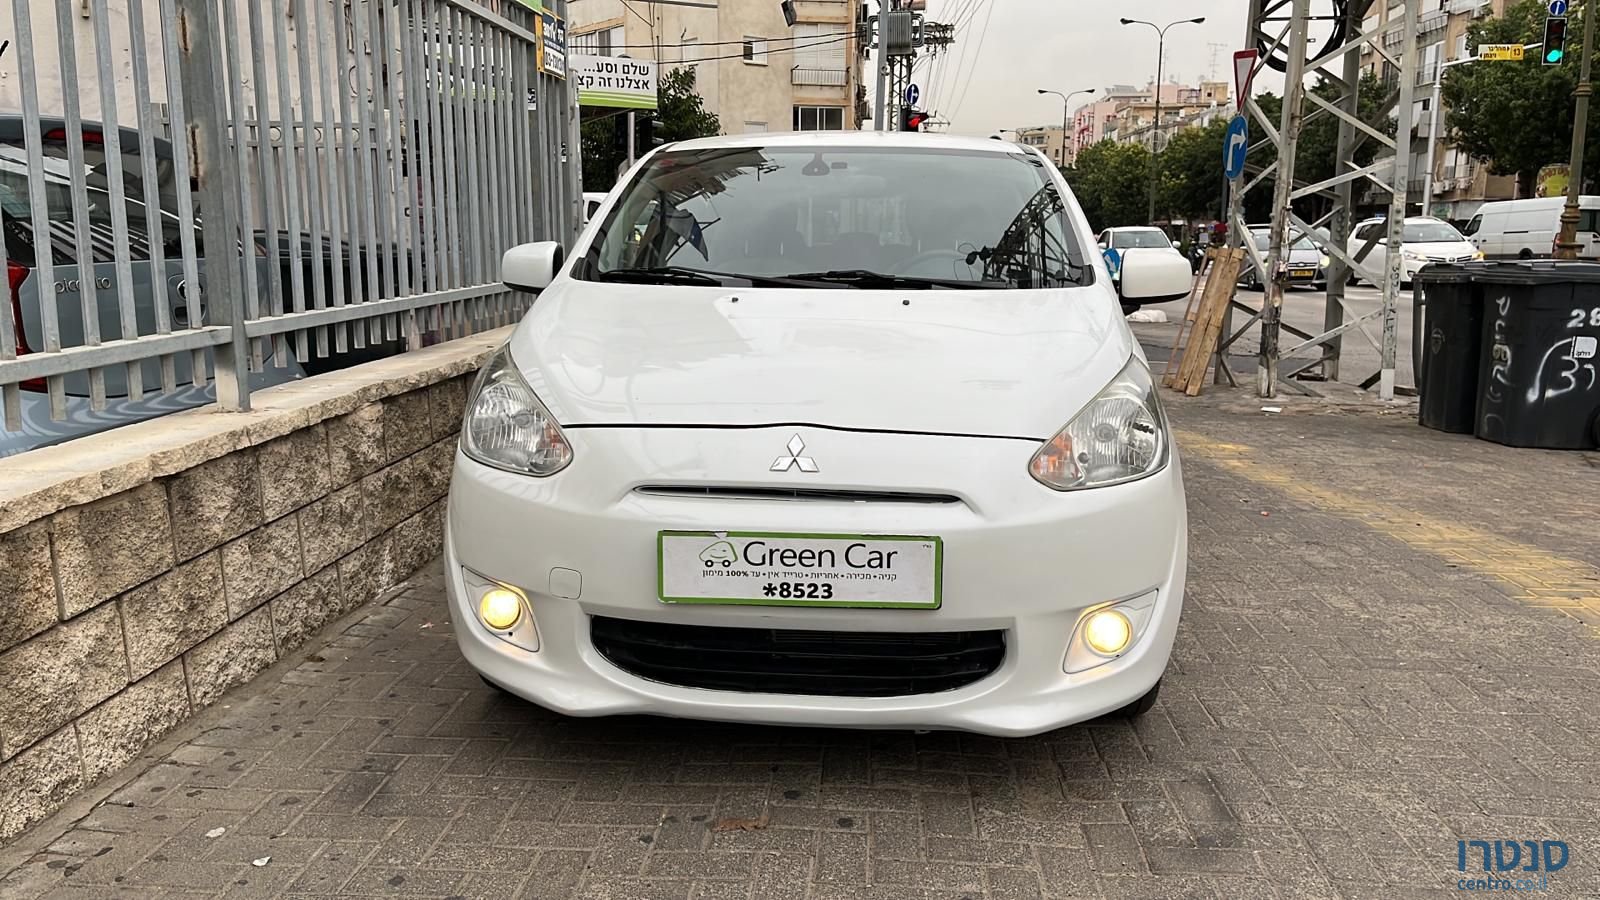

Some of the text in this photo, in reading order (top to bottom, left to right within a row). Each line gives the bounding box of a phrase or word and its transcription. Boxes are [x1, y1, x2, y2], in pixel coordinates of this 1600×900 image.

[1513, 48, 1521, 56] 13
[622, 63, 649, 76] שלם
[577, 75, 650, 90] אצלנו זה קצ
[743, 541, 898, 569] Green Car
[702, 570, 723, 578] מימון
[768, 571, 780, 579] אין
[783, 571, 803, 579] טרייד
[878, 573, 897, 582] קניה
